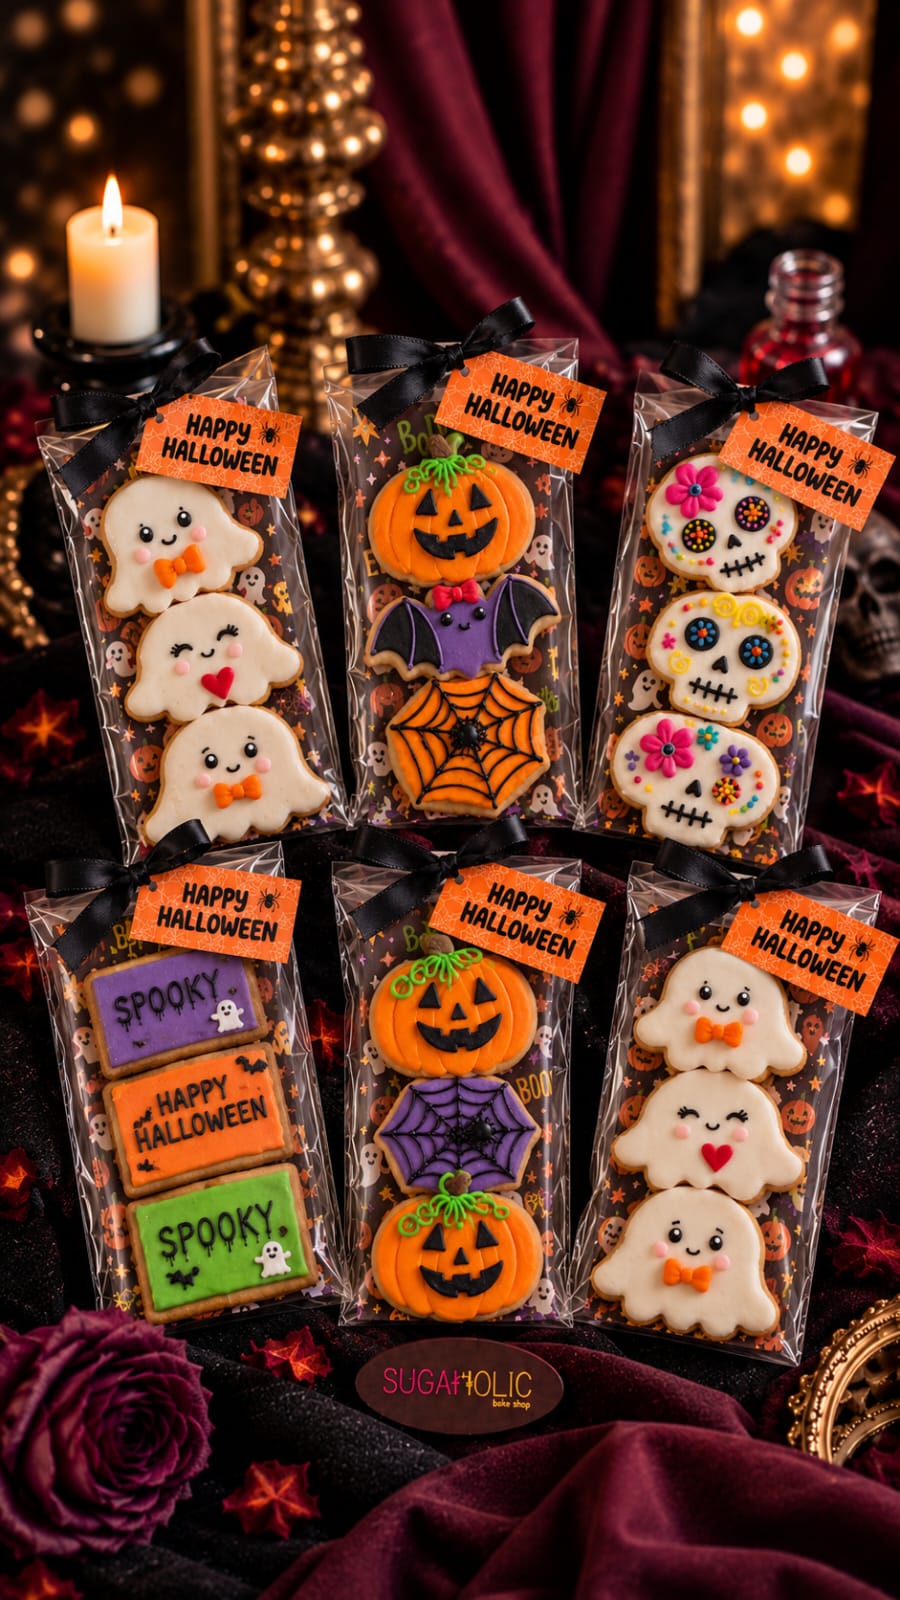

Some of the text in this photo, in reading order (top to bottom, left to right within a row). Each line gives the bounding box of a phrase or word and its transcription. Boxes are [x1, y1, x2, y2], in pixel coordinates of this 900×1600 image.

[491, 373, 555, 412] HAPPY
[186, 414, 251, 445] HAPPY
[465, 393, 579, 449] HALLOWEEN
[162, 437, 278, 476] HALLOWEEN
[779, 423, 843, 468] HAPPY
[748, 439, 861, 506] HALLOWEEN
[183, 883, 248, 912] HAPPY
[488, 883, 552, 922] HAPPY
[158, 906, 277, 941] HALLOWEEN
[460, 902, 576, 959] HALLOWEEN
[780, 910, 845, 954] HAPPY
[751, 927, 866, 992] HALLOWEEN
[114, 968, 220, 1032] SPOOKY
[157, 1075, 227, 1116] HAPPY
[134, 1096, 268, 1153] HALLOWEEN
[158, 1200, 273, 1267] SPOOKY
[492, 1399, 531, 1411] bake shop
